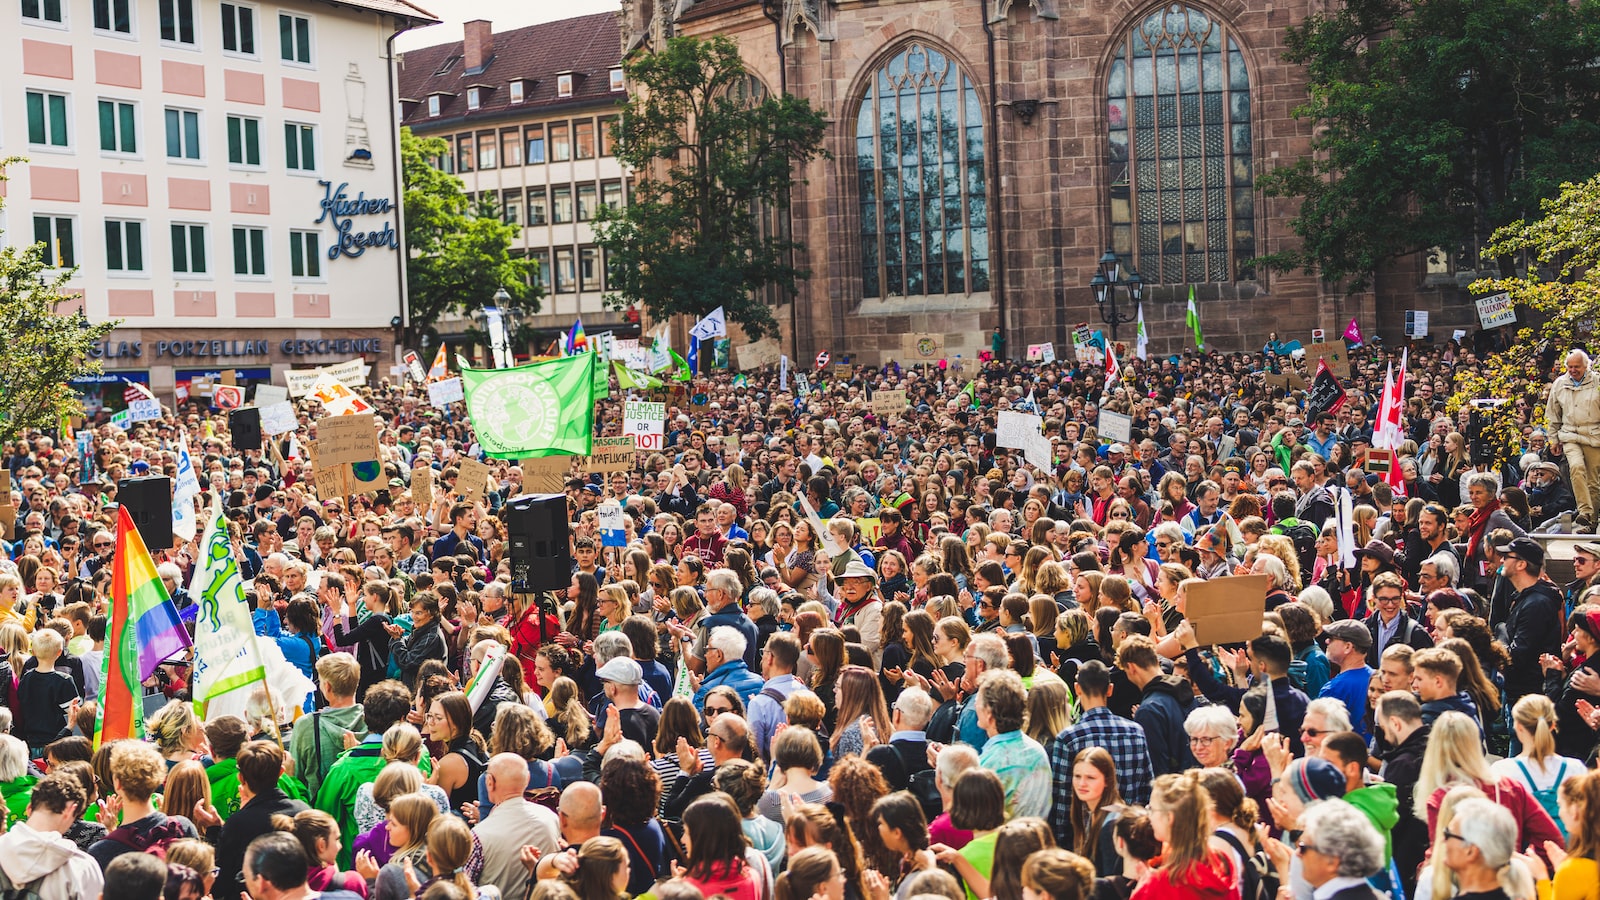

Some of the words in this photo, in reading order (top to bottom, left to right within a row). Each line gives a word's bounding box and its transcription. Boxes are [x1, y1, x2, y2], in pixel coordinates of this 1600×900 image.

[328, 219, 399, 259] Loesch
[88, 340, 143, 358] GLAS
[156, 339, 269, 357] PORZELLAN
[280, 337, 382, 355] GESCHENKE
[625, 402, 664, 412] CLIMATE
[625, 411, 664, 421] JUSTICE
[637, 422, 650, 431] OR
[592, 437, 631, 447] MASCHUTZ
[580, 451, 632, 465] KIMAFLUCHT
